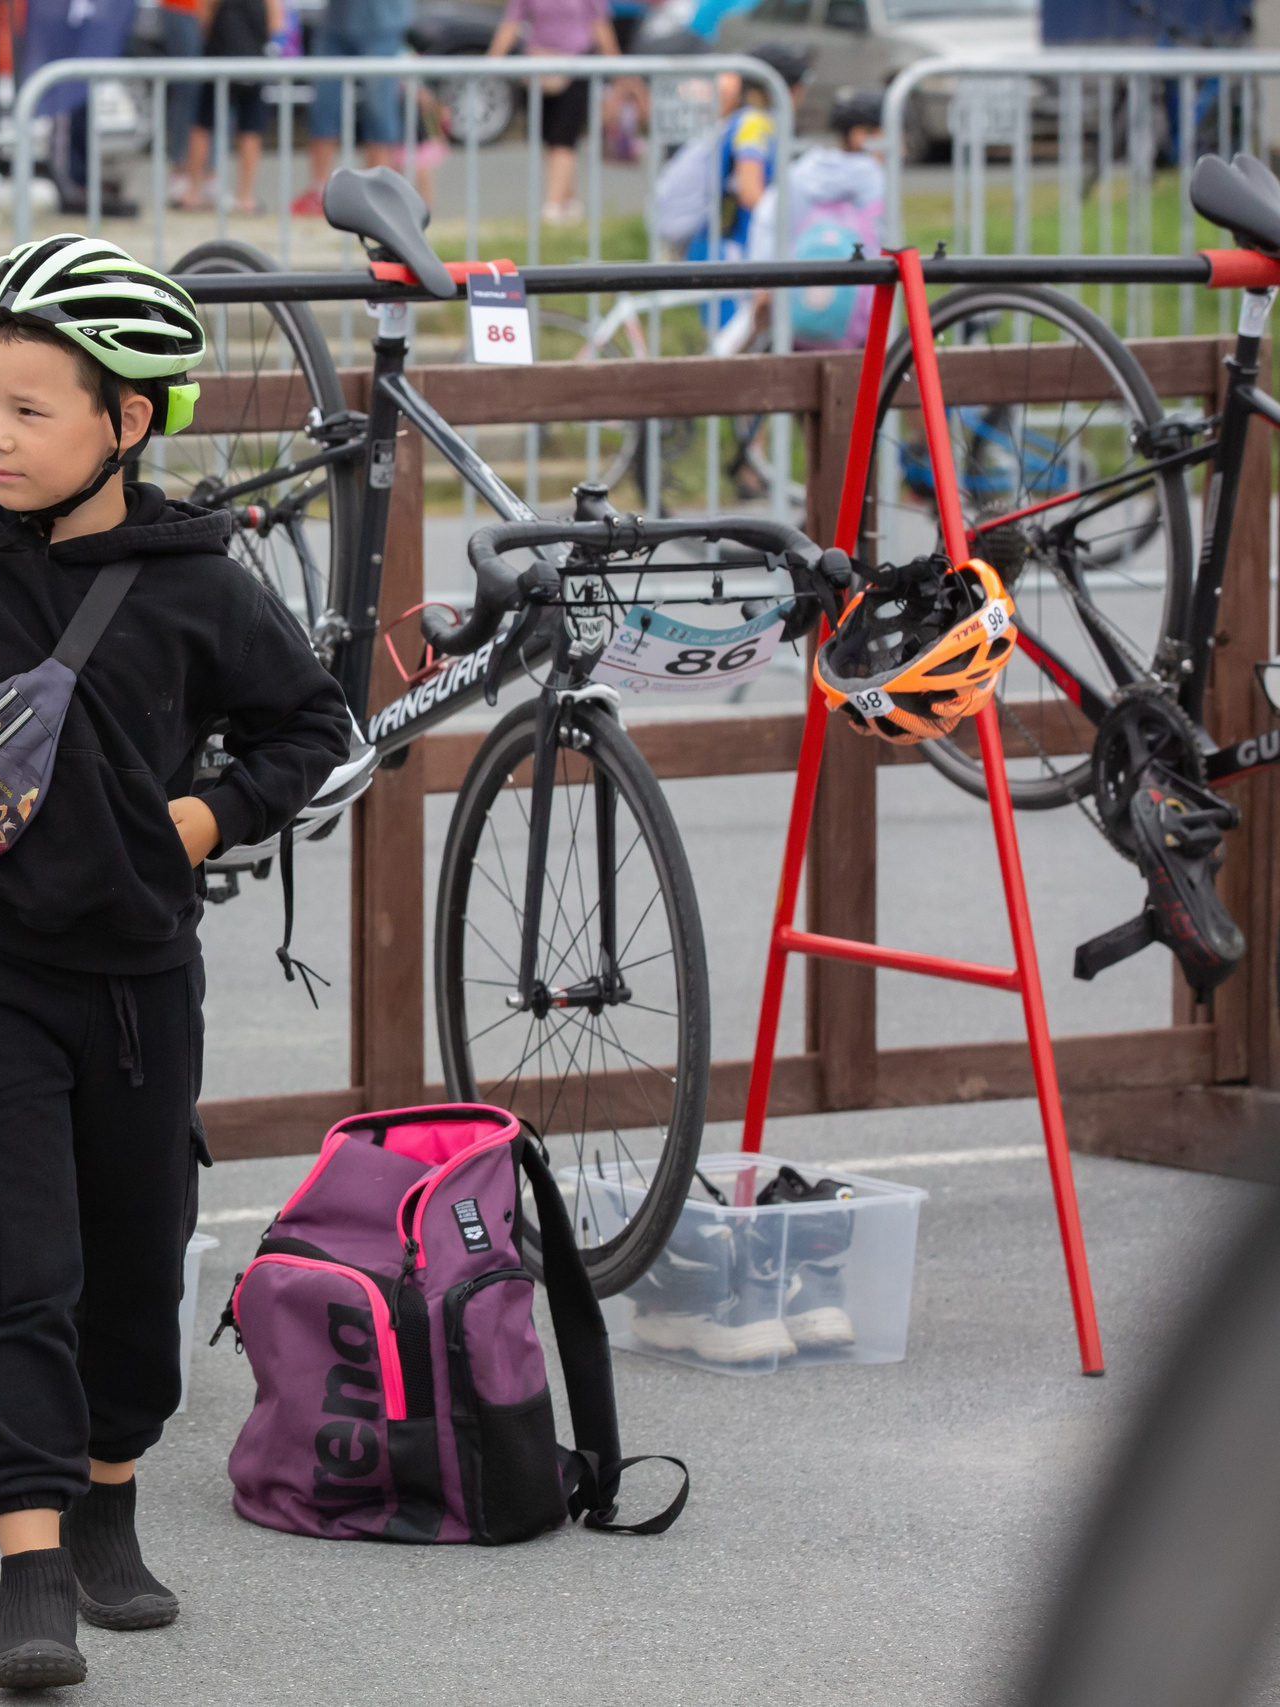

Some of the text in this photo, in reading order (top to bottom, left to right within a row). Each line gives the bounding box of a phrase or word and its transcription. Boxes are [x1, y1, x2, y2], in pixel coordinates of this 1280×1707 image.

[487, 325, 516, 343] 86
[664, 637, 762, 676] 86
[367, 632, 508, 743] VANGUAR
